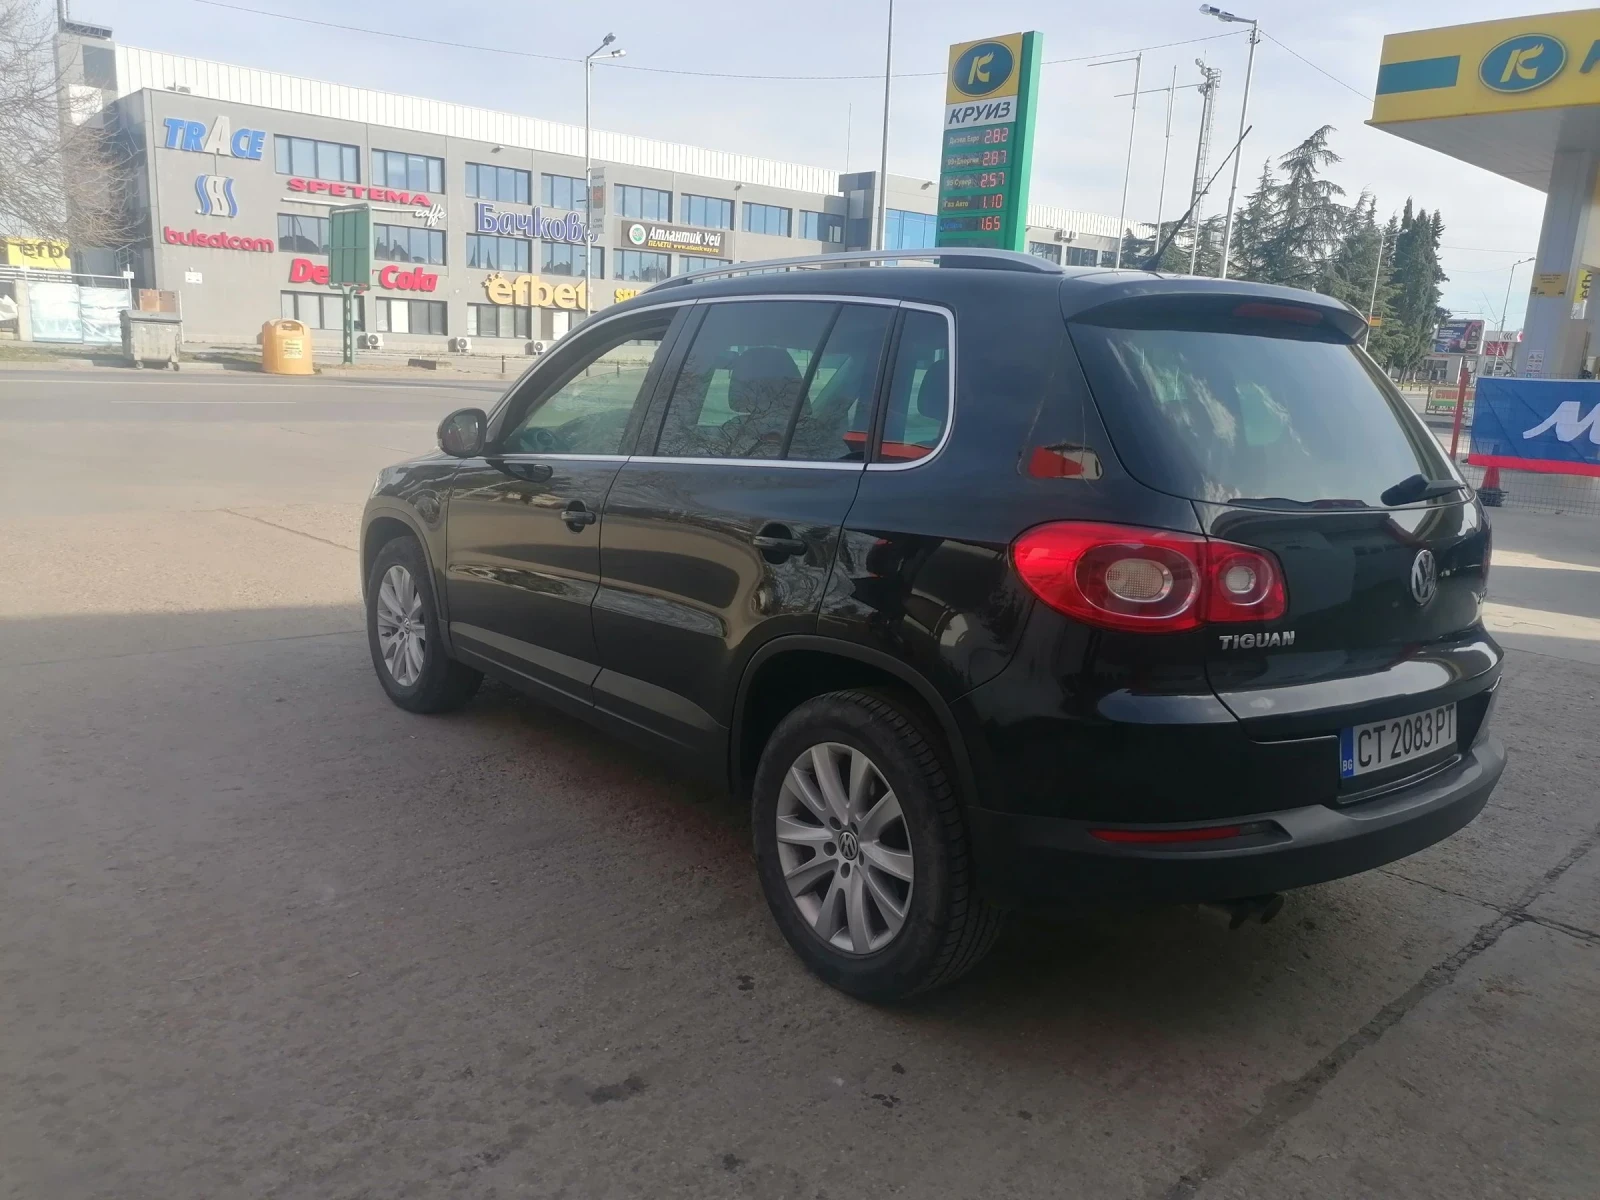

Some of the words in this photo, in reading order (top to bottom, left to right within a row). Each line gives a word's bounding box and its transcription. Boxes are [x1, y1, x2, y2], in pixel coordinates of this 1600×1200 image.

[948, 101, 1011, 125] КРУИЗ
[164, 115, 267, 161] TRACE
[984, 127, 1009, 144] 2.82
[982, 150, 1007, 166] 2.87
[980, 172, 1005, 188] 2.57
[287, 178, 431, 207] SPETEMA
[164, 226, 275, 253] bulsatcom
[648, 226, 703, 245] Атлантик
[703, 231, 721, 247] Уей
[379, 264, 438, 293] Cola
[1219, 631, 1295, 650] TIGUAN
[1357, 725, 1387, 768] CT
[1390, 714, 1433, 761] 2083
[1434, 706, 1455, 745] PT
[1342, 759, 1353, 771] BG
